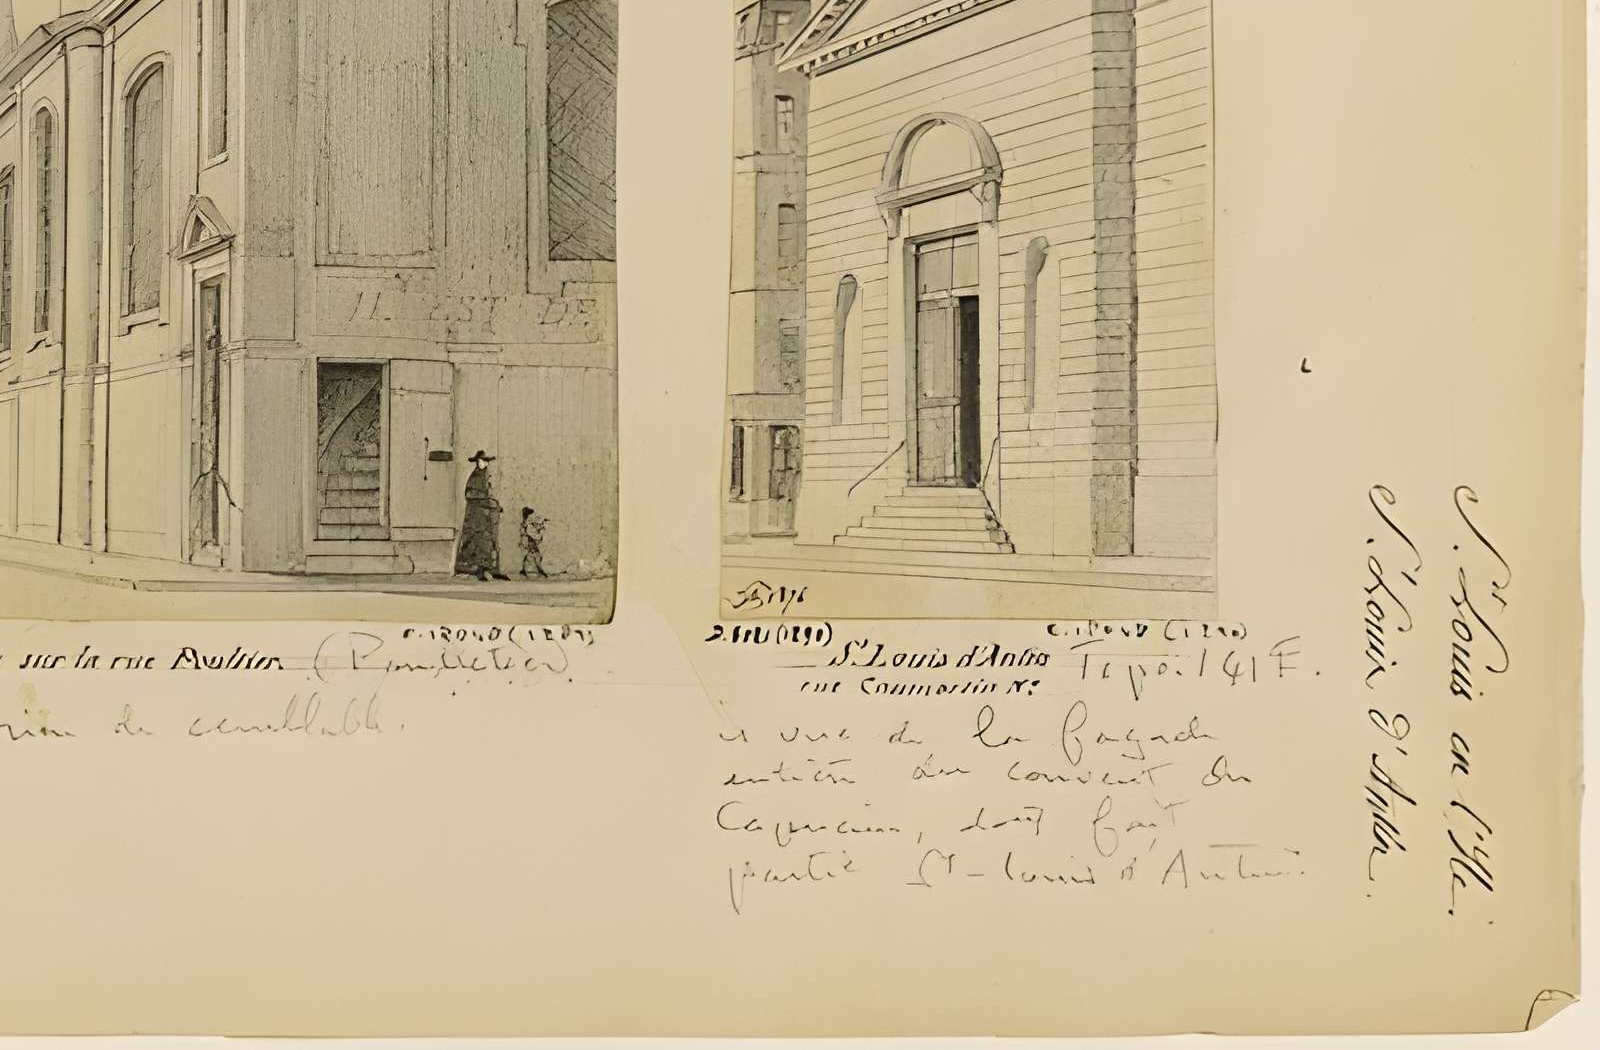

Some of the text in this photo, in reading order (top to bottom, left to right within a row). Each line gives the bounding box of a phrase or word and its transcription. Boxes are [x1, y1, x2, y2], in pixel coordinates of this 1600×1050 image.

[19, 652, 66, 670] sur
[74, 645, 101, 670] la
[109, 654, 155, 670] rue
[857, 643, 948, 669] Louis
[1362, 554, 1414, 690] Louis
[1448, 566, 1510, 702] Louis
